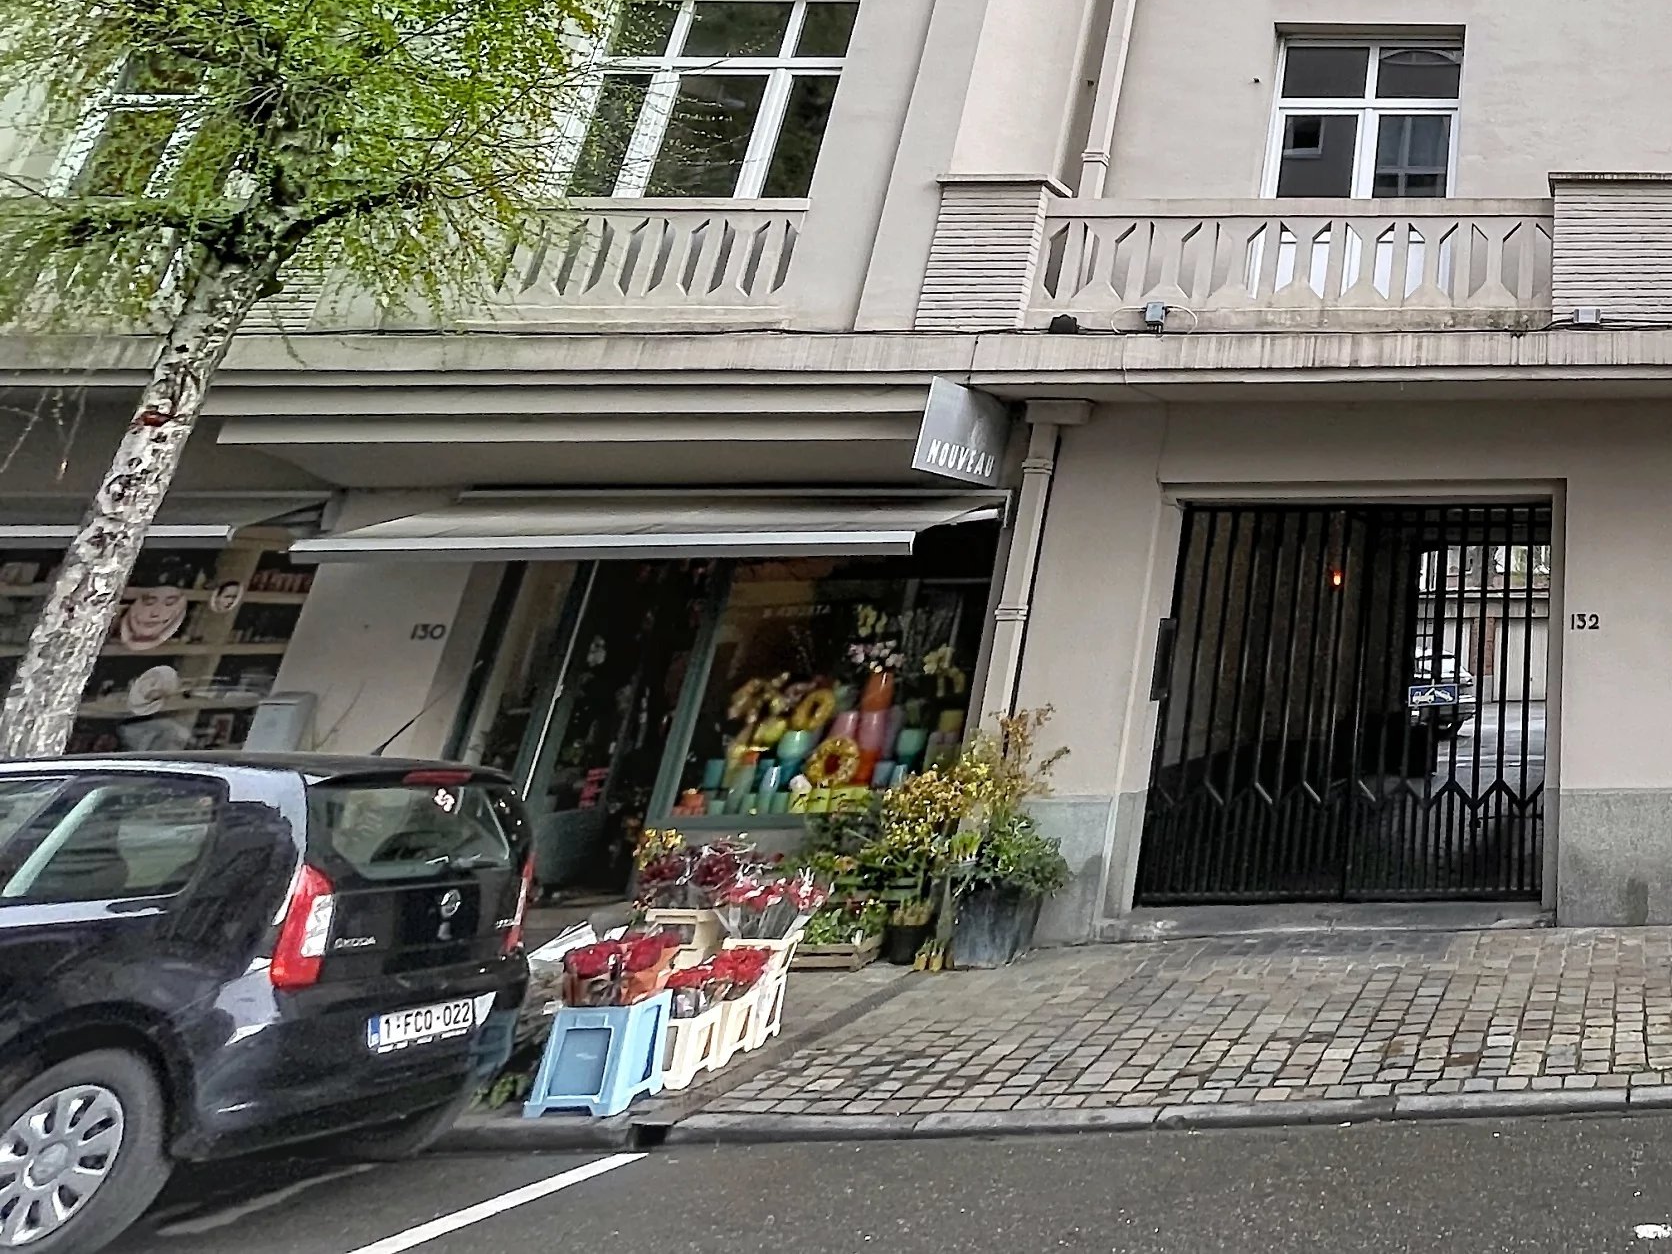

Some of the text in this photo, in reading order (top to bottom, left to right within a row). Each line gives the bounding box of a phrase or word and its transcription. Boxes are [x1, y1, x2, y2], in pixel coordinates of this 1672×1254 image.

[926, 438, 995, 478] NOUVEAU
[1571, 613, 1600, 630] 132
[410, 623, 447, 640] 130
